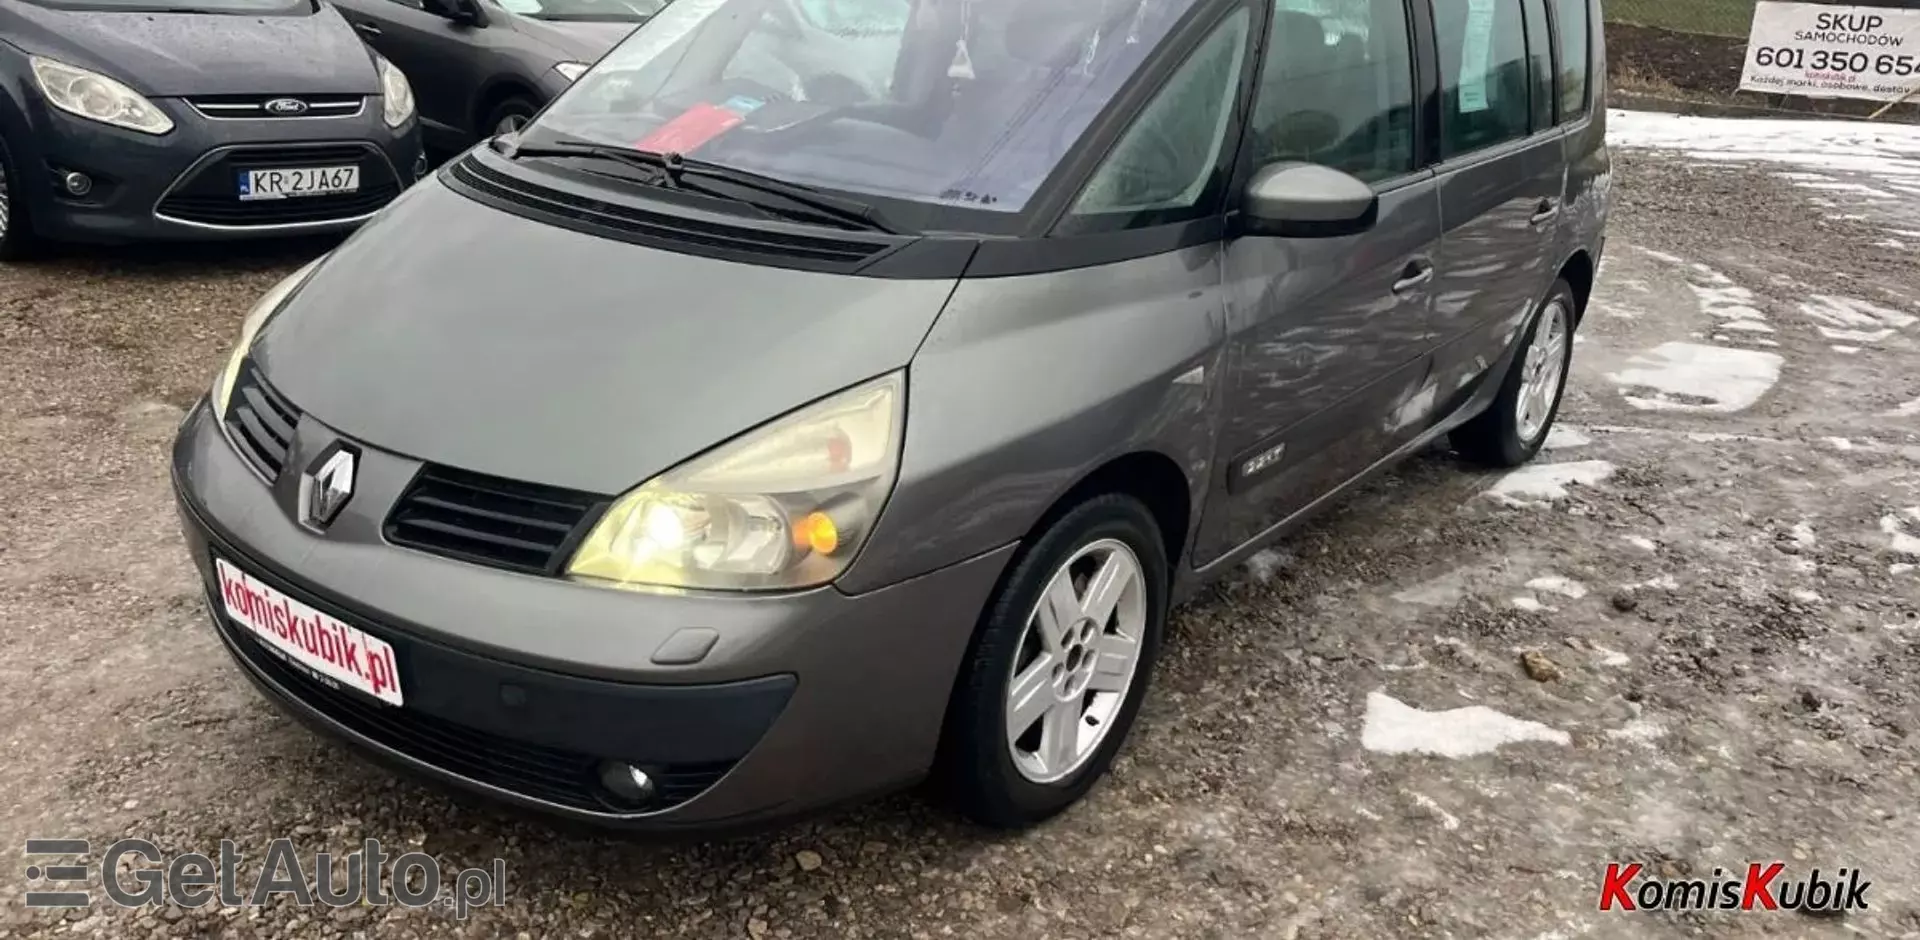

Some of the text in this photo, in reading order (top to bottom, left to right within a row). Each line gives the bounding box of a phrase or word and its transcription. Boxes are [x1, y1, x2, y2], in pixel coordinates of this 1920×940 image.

[1816, 12, 1883, 33] SKUP
[1794, 31, 1903, 46] SAMOCHODÓW
[1756, 46, 1803, 69] 601
[1810, 50, 1868, 73] 350
[254, 171, 283, 193] KR
[292, 168, 354, 191] 2JA67
[219, 561, 397, 694] komiskubik.pl
